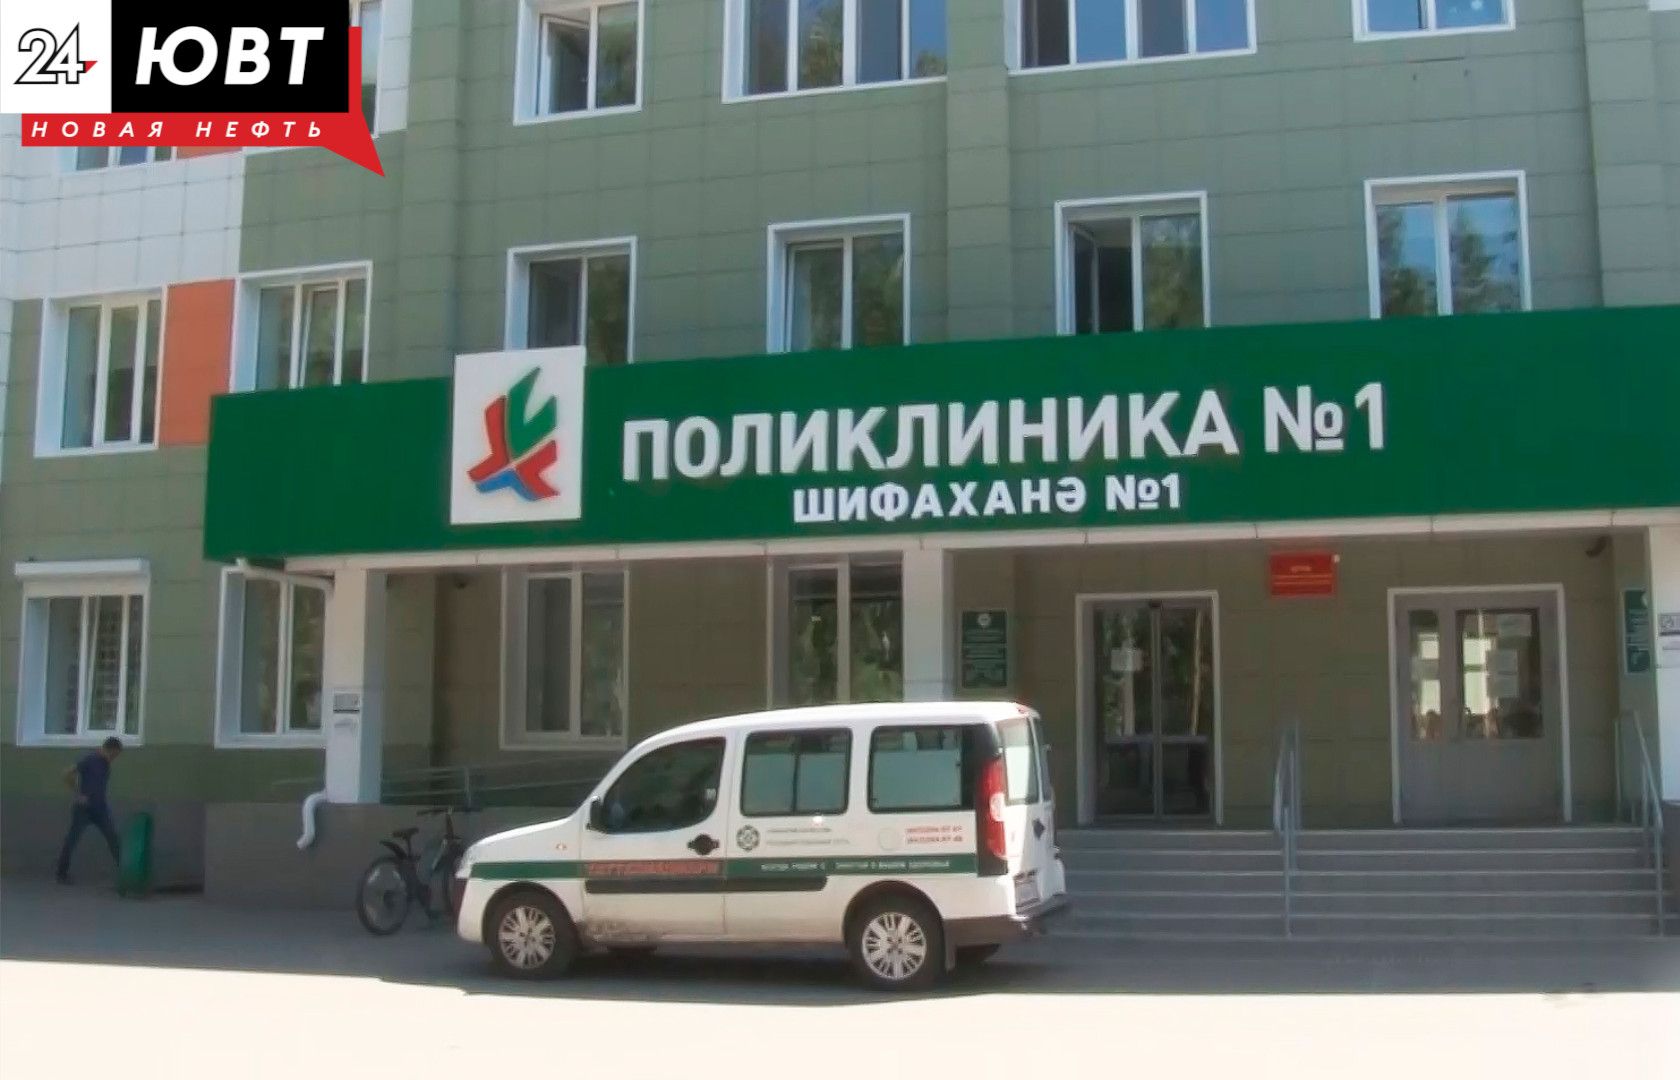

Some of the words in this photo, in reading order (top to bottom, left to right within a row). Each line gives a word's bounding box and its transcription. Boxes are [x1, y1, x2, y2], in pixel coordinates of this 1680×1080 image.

[622, 390, 1240, 481] ПОЛИКЛИНИКА
[1264, 383, 1385, 454] №1
[792, 480, 1087, 524] ШИФАХАНӘ
[1105, 473, 1181, 511] №1
